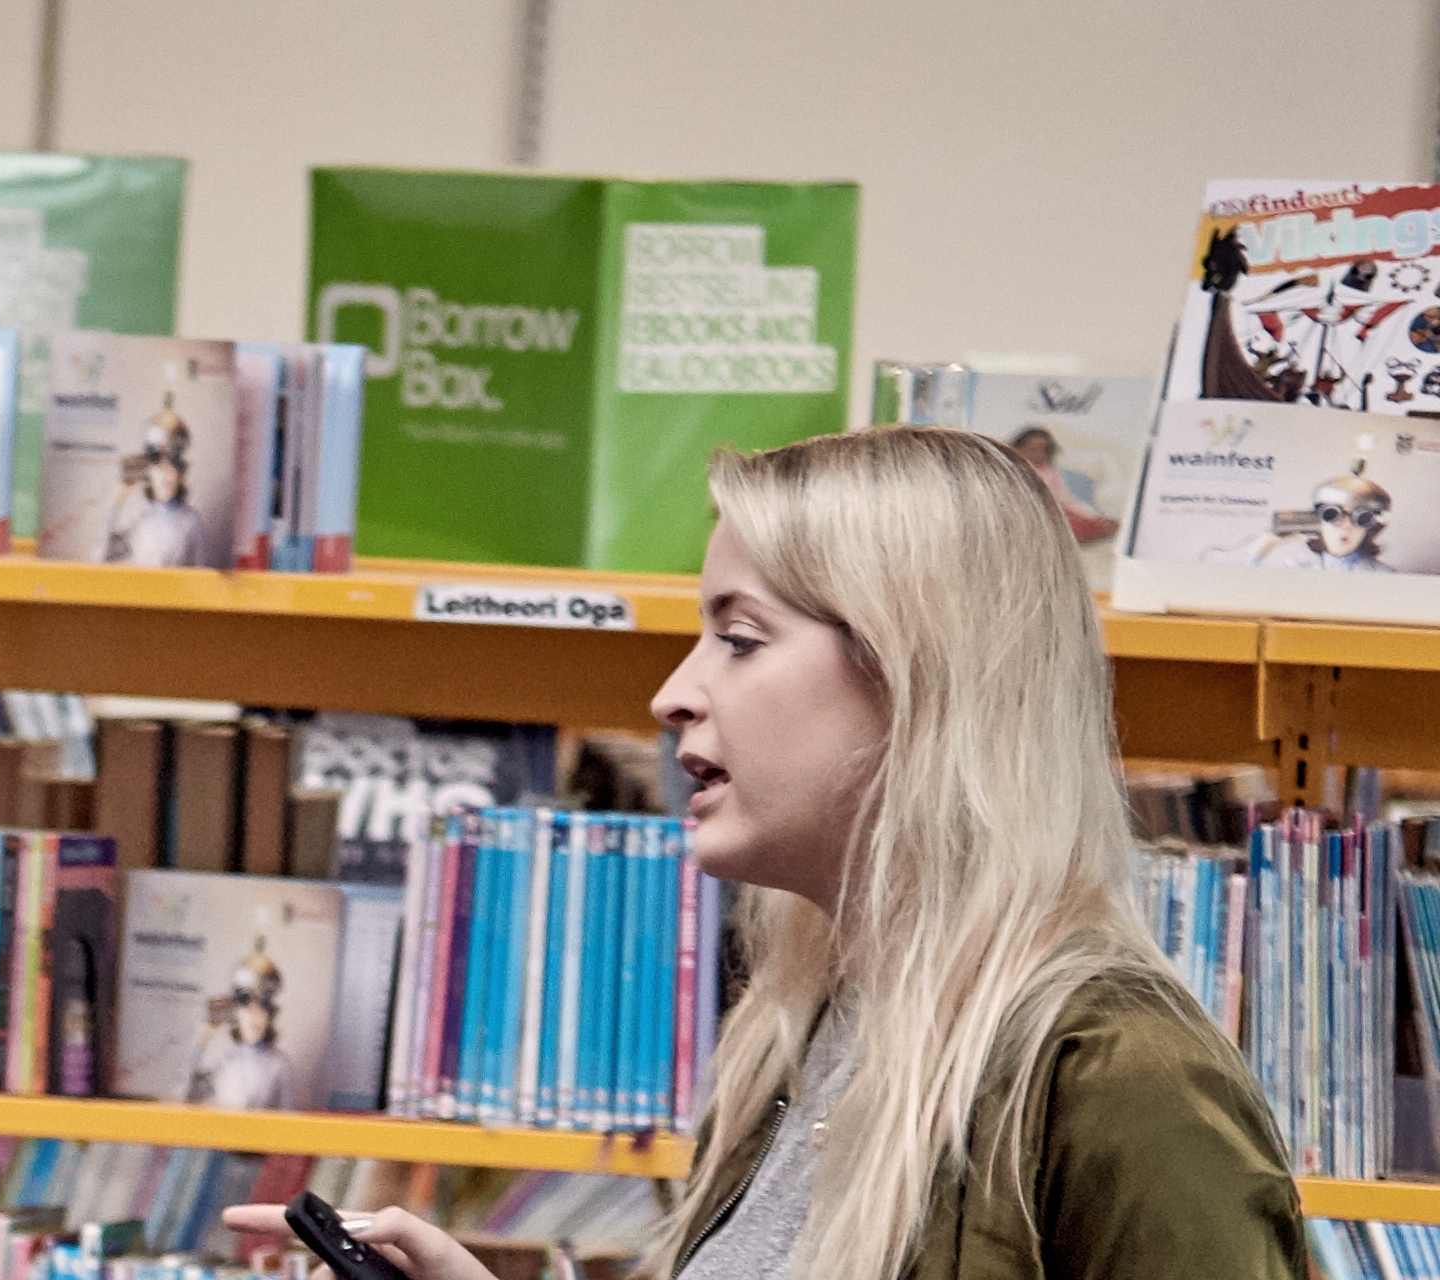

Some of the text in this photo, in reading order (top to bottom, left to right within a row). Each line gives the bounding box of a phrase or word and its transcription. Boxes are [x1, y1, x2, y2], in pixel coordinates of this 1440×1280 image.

[400, 287, 580, 352] Borrow
[1169, 451, 1276, 471] wainfest
[568, 598, 625, 626] Oga
